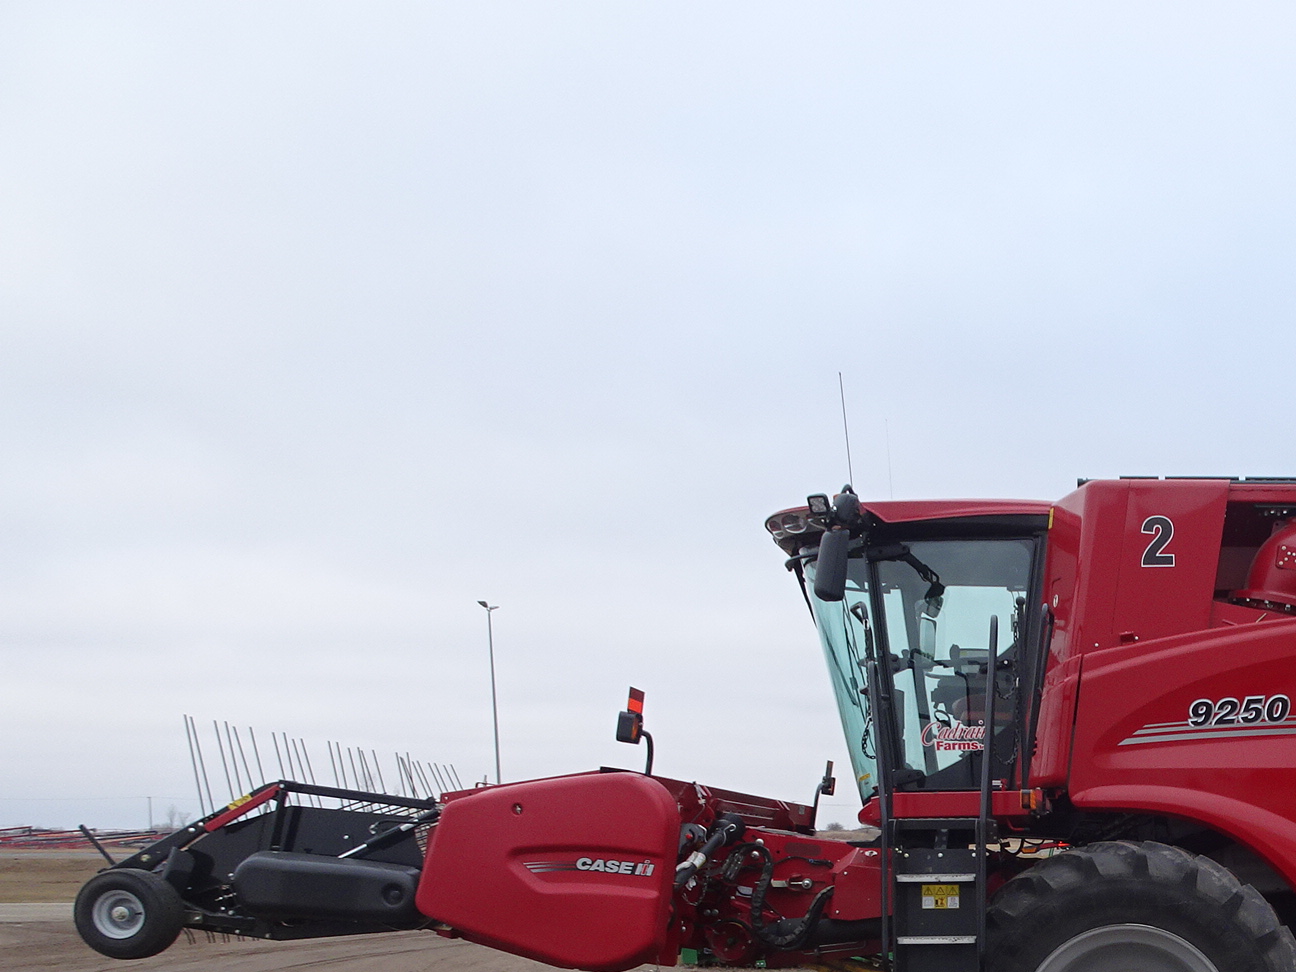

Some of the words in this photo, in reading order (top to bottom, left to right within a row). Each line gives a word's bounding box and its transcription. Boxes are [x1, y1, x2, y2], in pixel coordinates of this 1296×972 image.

[1140, 515, 1176, 567] 2
[1188, 694, 1291, 728] 9250
[935, 741, 979, 751] Farms
[576, 857, 635, 875] CASE
